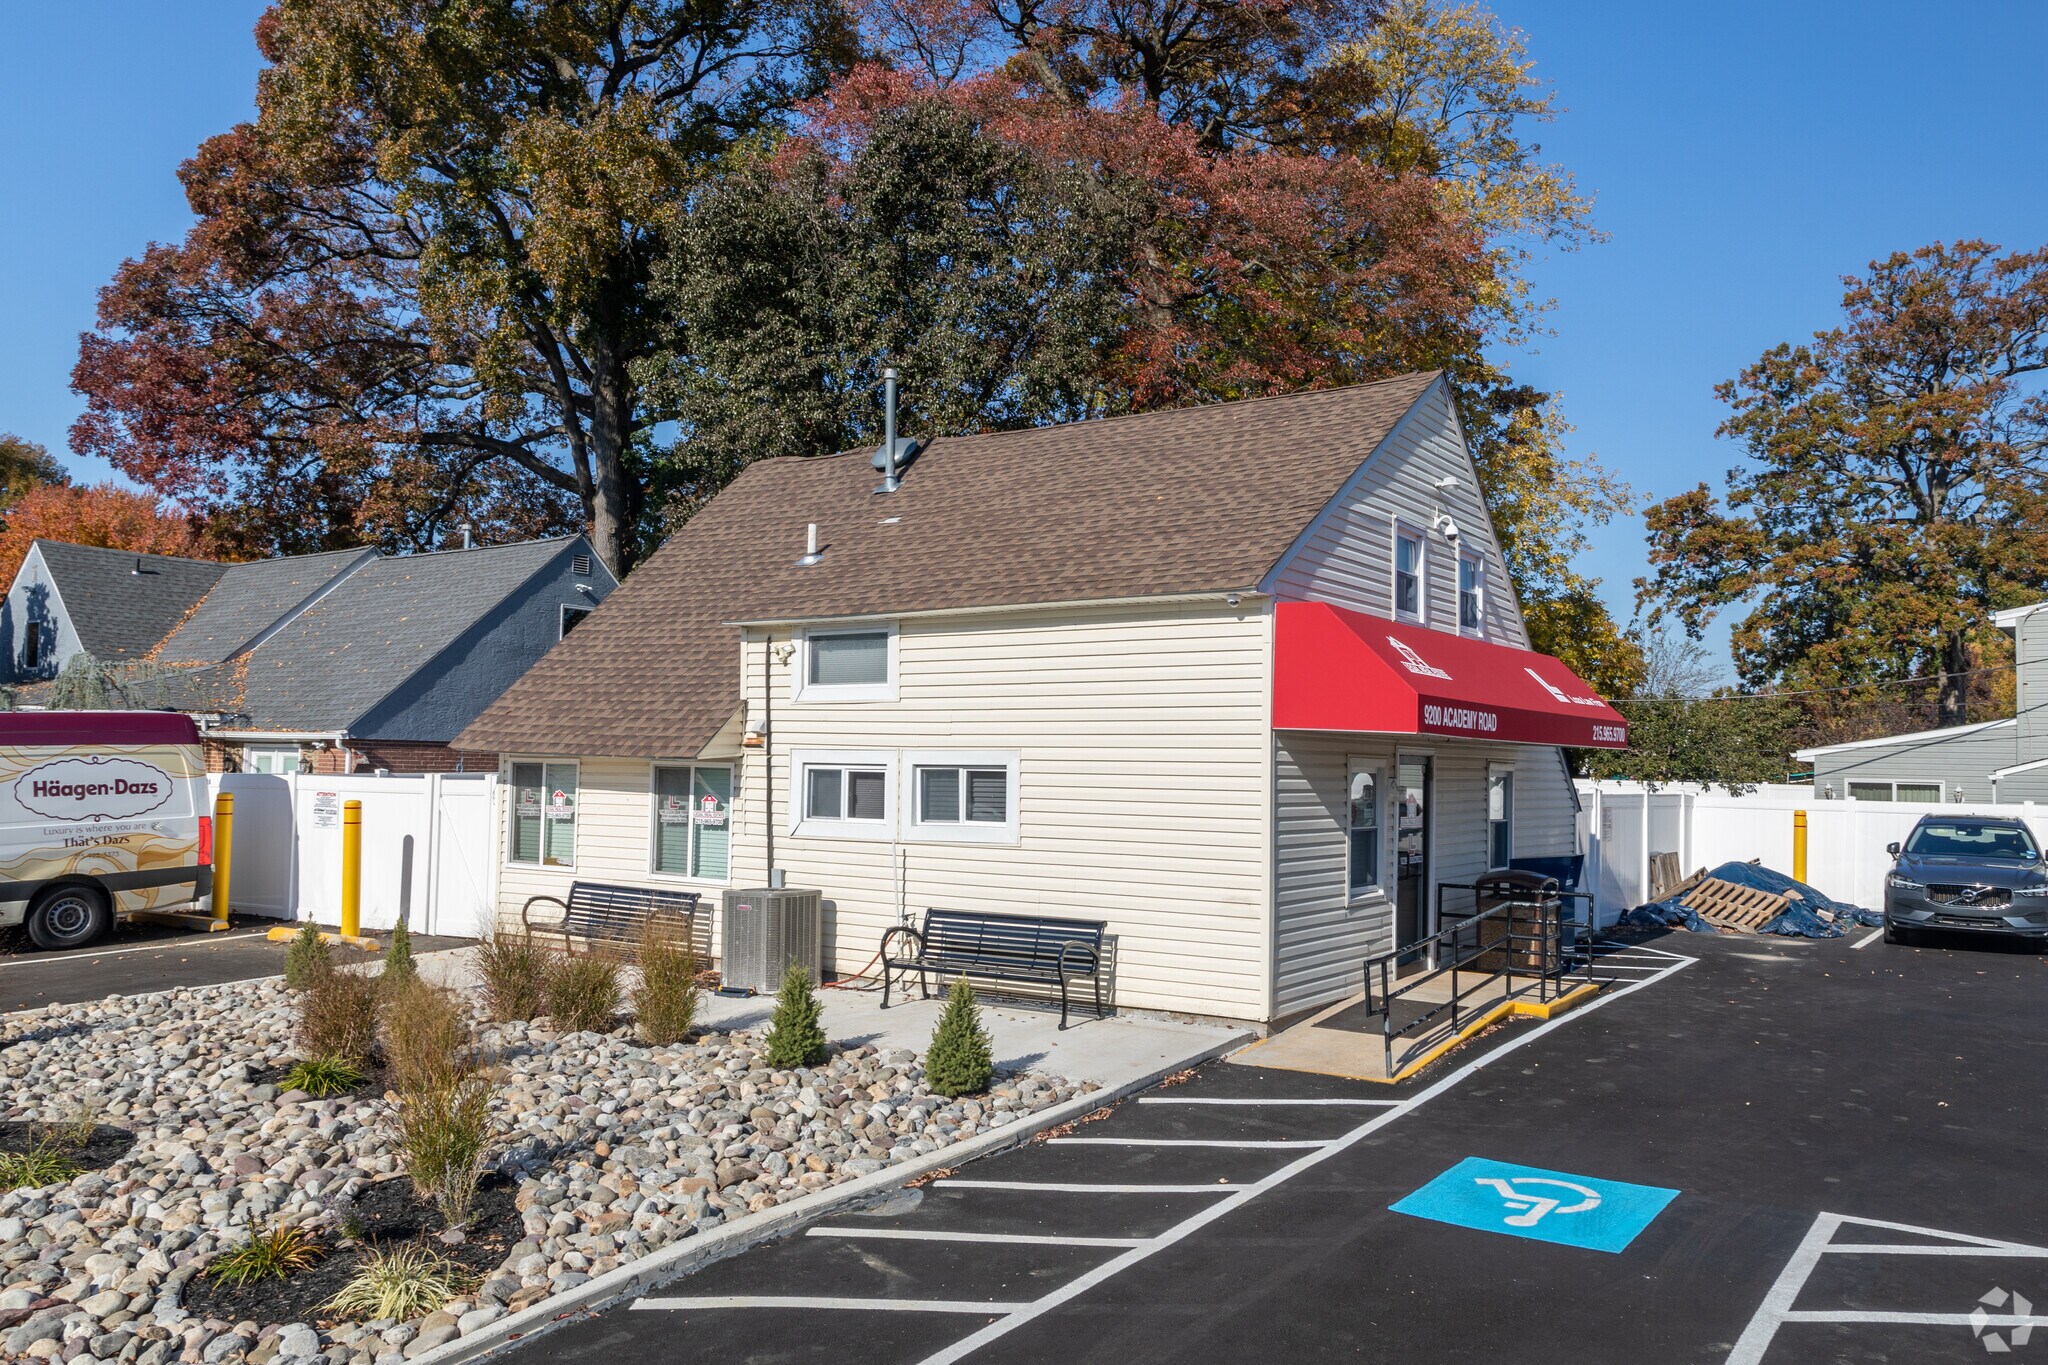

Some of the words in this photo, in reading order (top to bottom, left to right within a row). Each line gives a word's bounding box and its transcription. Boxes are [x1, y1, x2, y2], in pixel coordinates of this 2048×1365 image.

[1424, 704, 1442, 725] 9200
[1442, 706, 1478, 730] ACADEMY
[1478, 711, 1498, 732] ROAD
[43, 827, 74, 836] Luxury
[76, 825, 83, 833] is
[85, 823, 113, 833] where
[116, 824, 132, 832] you
[133, 822, 147, 830] are
[103, 835, 130, 845] Dazs
